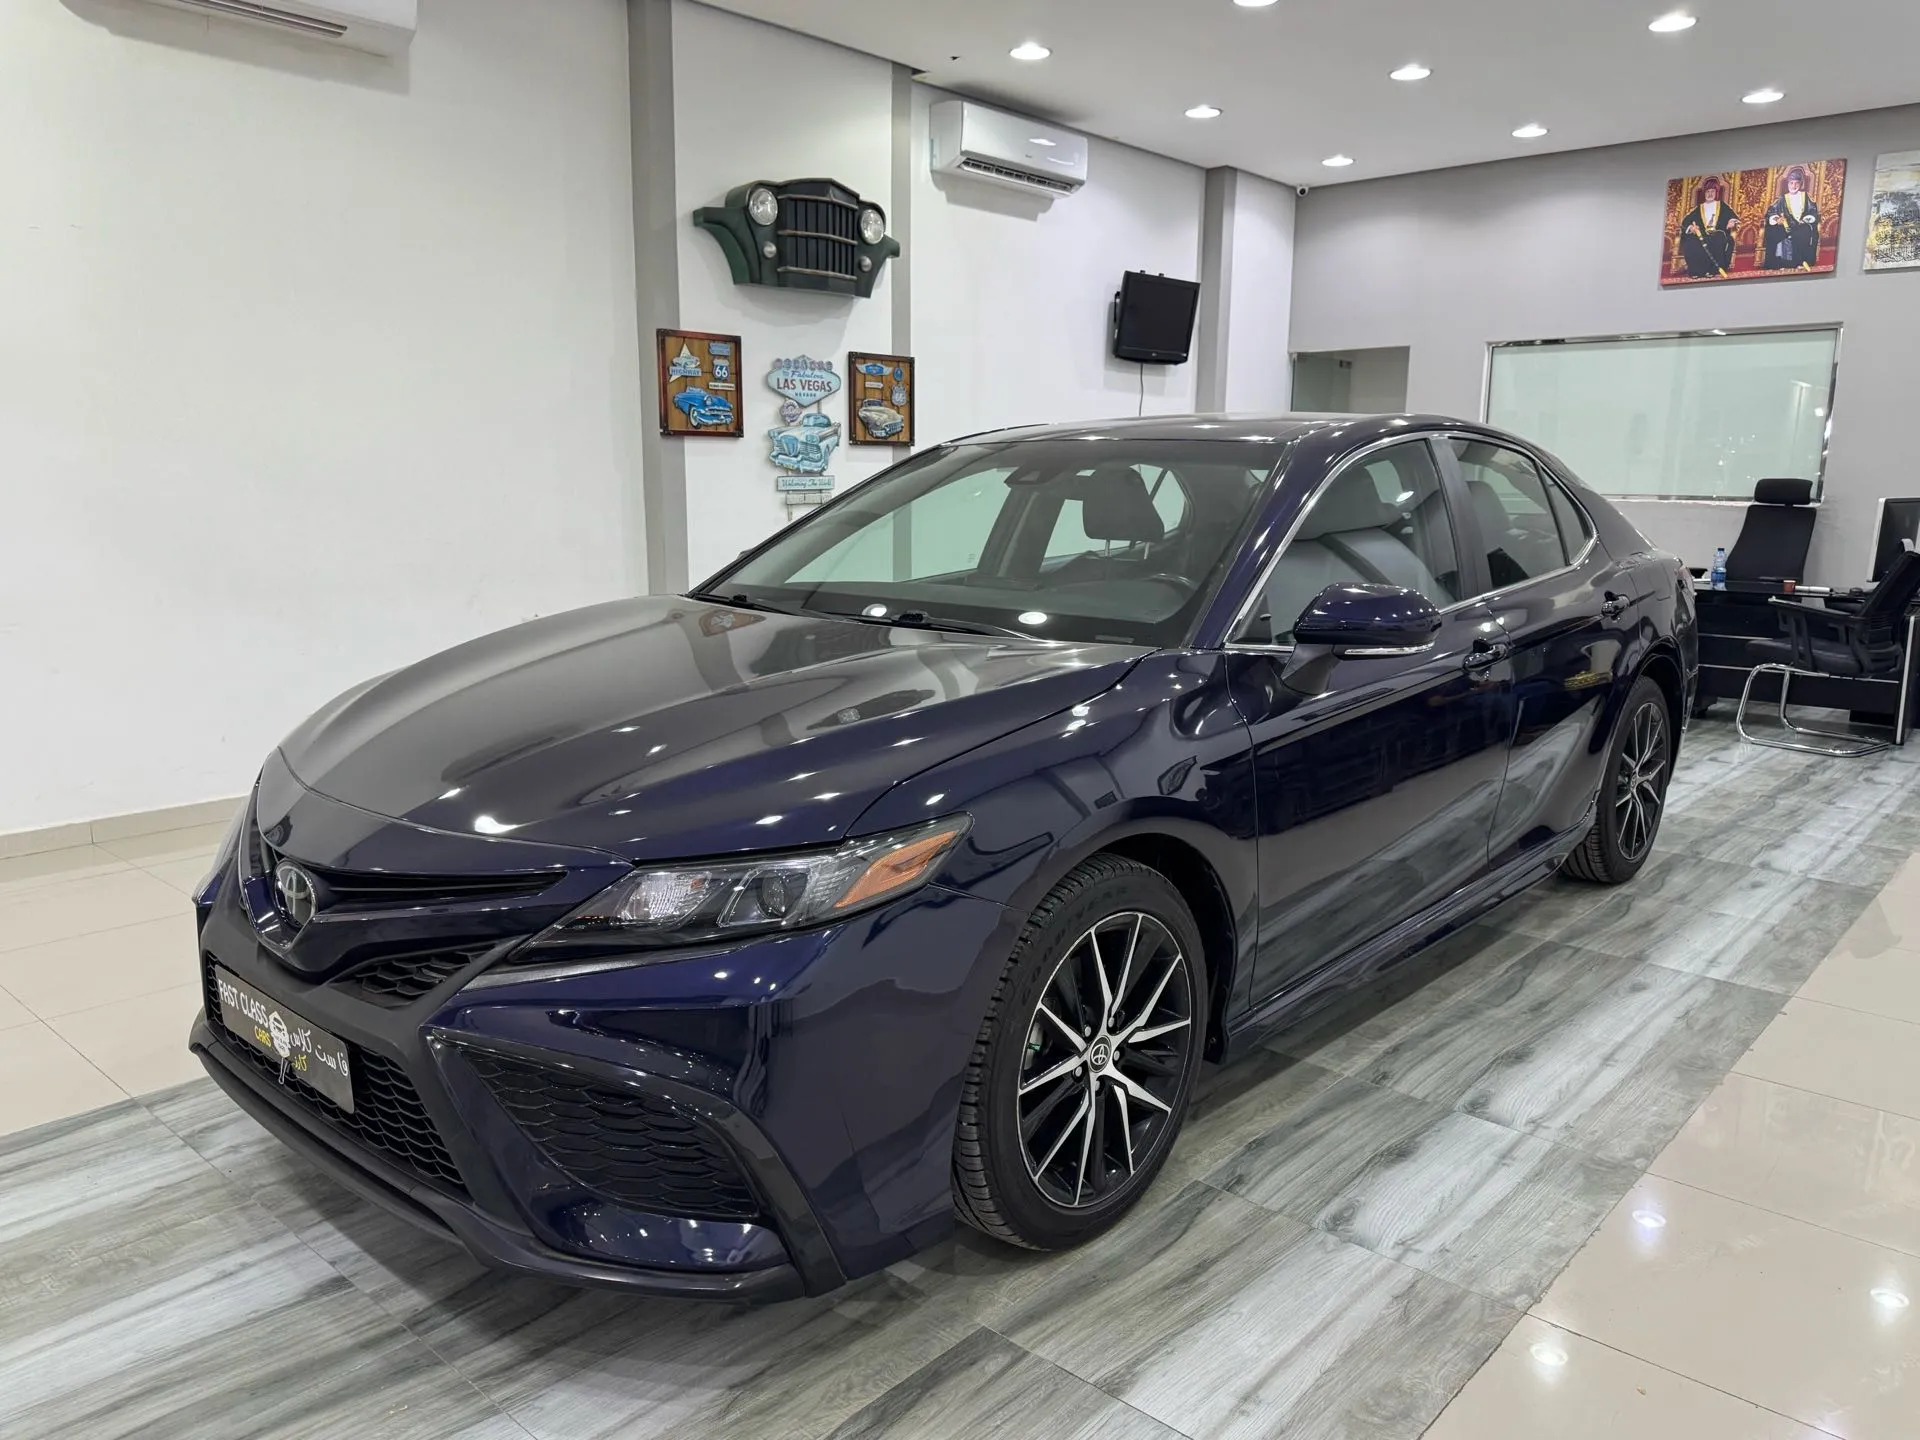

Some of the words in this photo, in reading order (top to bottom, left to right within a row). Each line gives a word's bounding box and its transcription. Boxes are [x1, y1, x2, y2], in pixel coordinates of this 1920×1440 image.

[715, 366, 728, 378] 66
[776, 377, 797, 391] LAS
[799, 379, 833, 393] VEGAS
[218, 979, 239, 1010] FAST
[240, 992, 269, 1028] CLASS
[254, 1025, 272, 1047] CARS
[290, 1027, 312, 1053] كلاس
